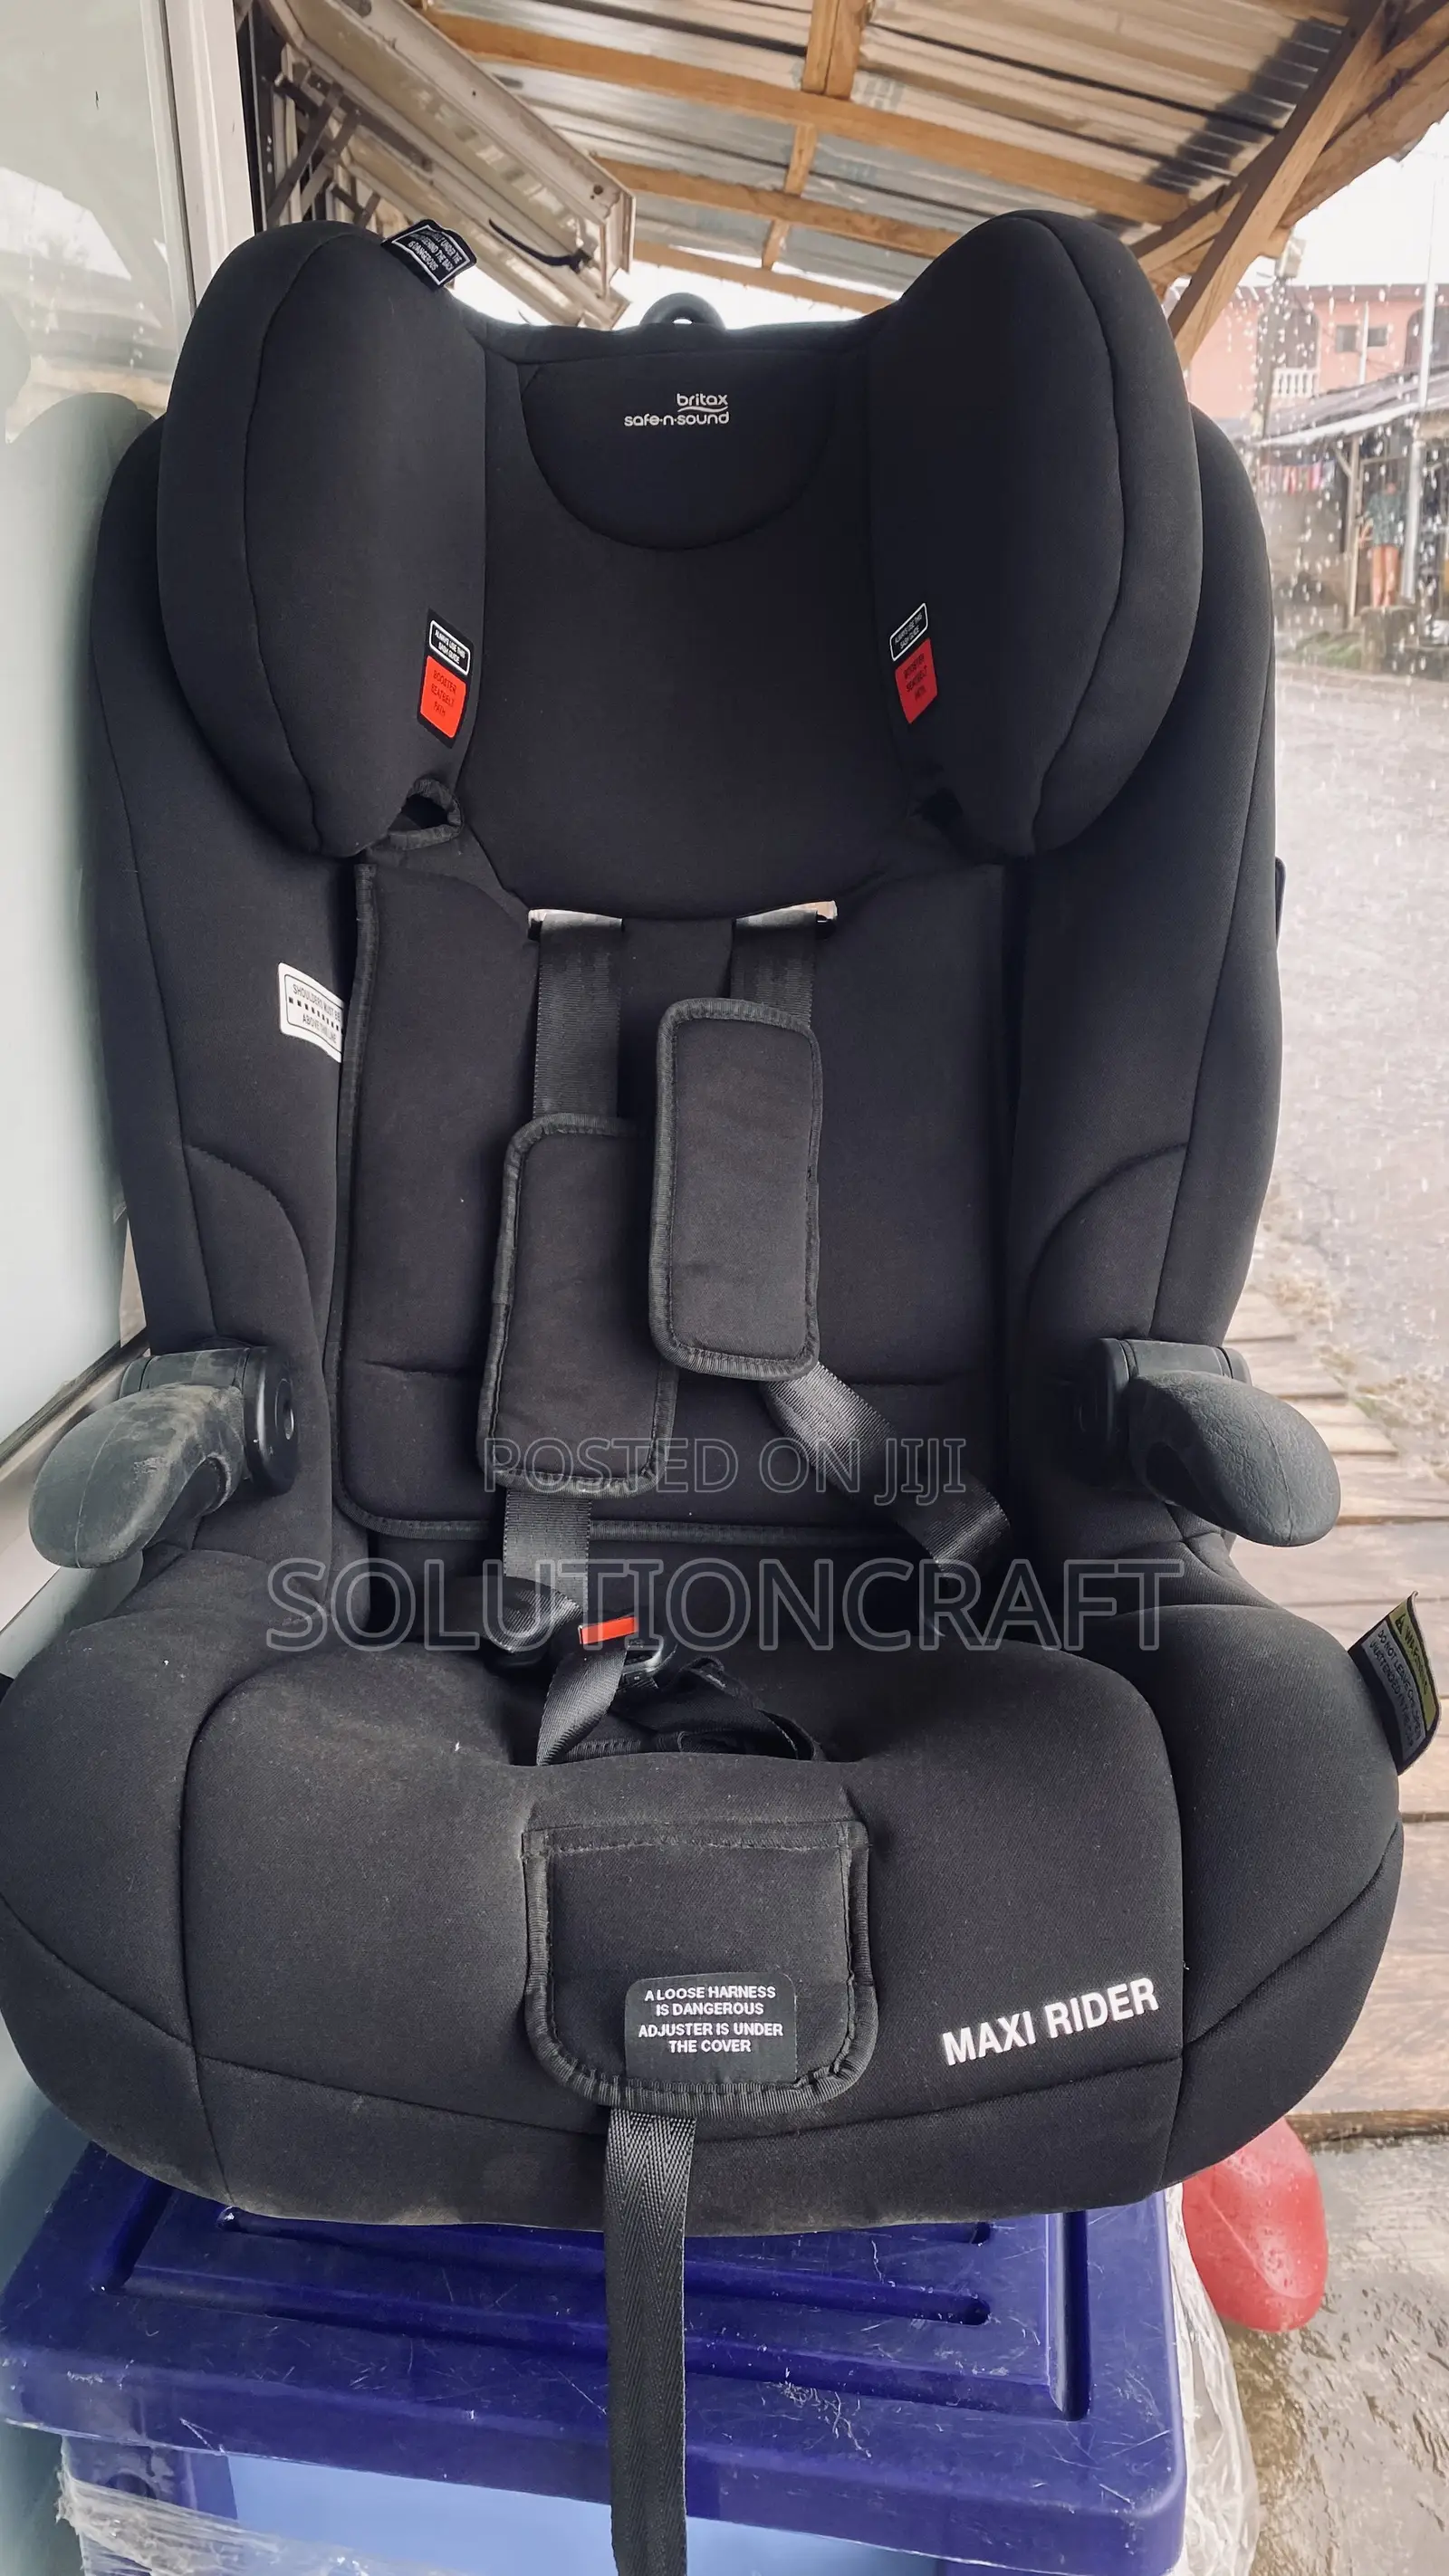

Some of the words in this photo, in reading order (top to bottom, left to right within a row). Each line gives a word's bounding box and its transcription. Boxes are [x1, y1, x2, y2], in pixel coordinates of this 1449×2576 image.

[677, 392, 729, 407] britax
[644, 1990, 654, 2002] A
[657, 1987, 705, 2001] LOOSE
[708, 1985, 776, 1999] HARNESS
[656, 2004, 669, 2016] IS
[672, 2002, 764, 2016] DANGEROUS
[943, 2010, 1037, 2066] MAXI
[1044, 1977, 1159, 2039] RIDER
[638, 2022, 714, 2038] ADJUSTER
[715, 2023, 729, 2036] IS
[733, 2022, 784, 2037] UNDER
[668, 2039, 698, 2054] THE
[700, 2038, 752, 2054] COVER
